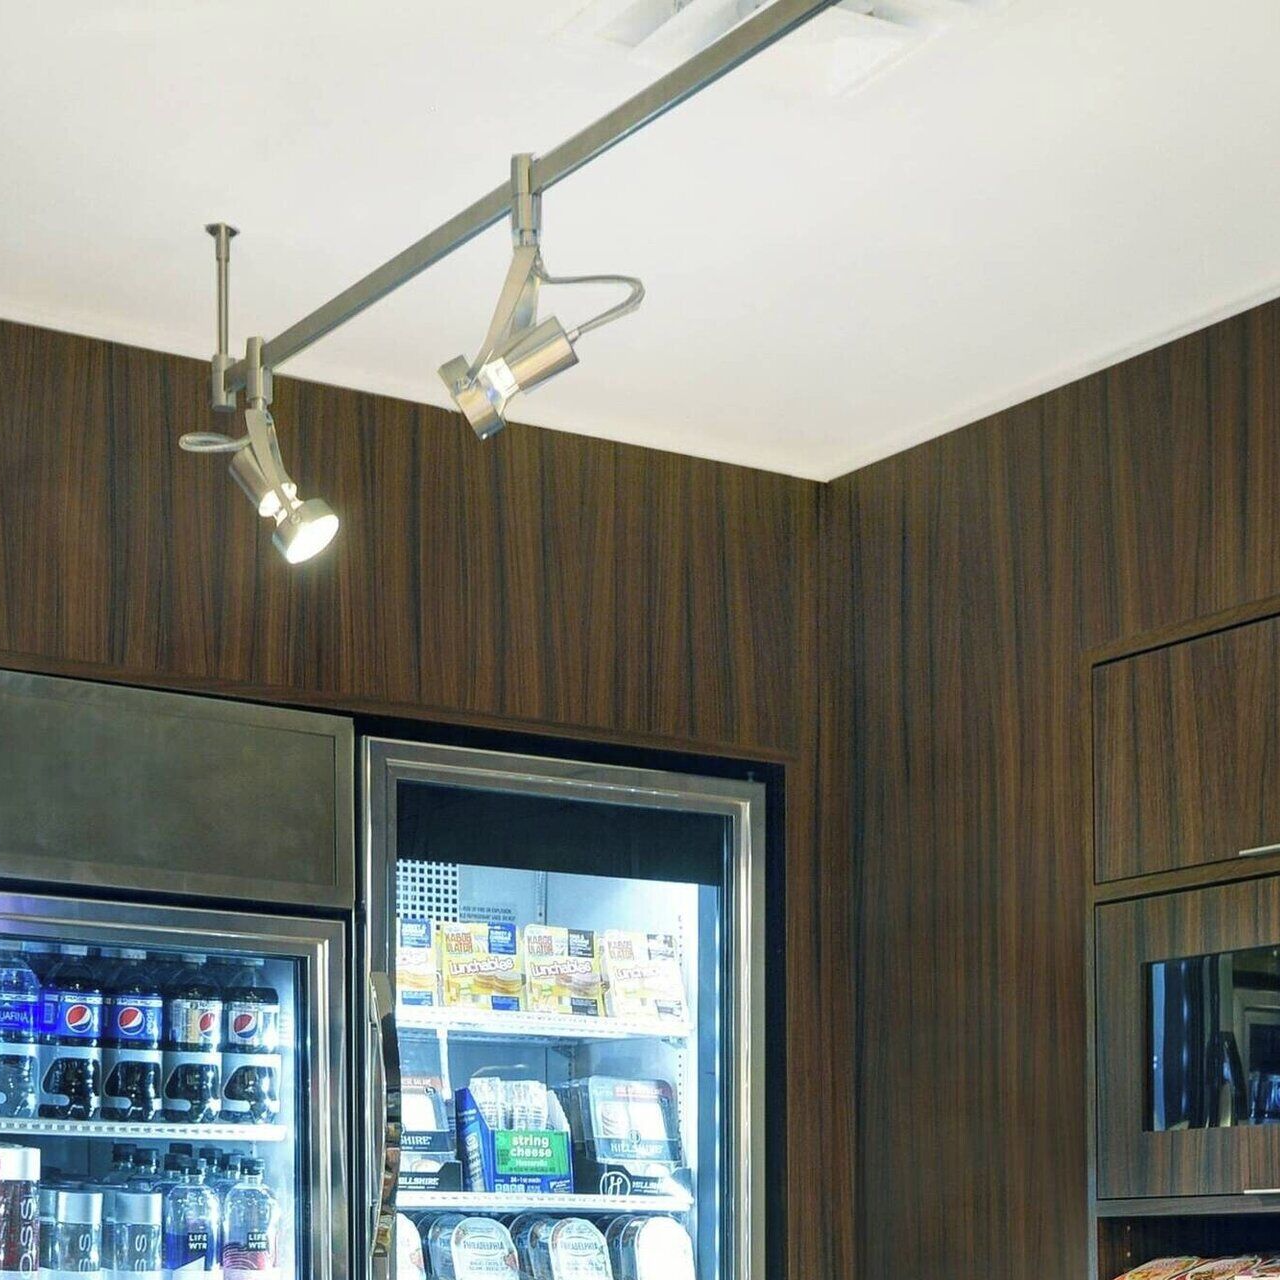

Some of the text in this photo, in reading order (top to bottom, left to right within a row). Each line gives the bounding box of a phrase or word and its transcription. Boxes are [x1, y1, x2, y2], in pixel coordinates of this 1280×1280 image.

[450, 957, 514, 976] Lunchables
[531, 957, 592, 977] Lunchables
[510, 1133, 549, 1150] string
[509, 1145, 553, 1158] cheese
[188, 1233, 207, 1241] LIFE
[248, 1233, 267, 1241] LIFE
[188, 1242, 207, 1250] WTR
